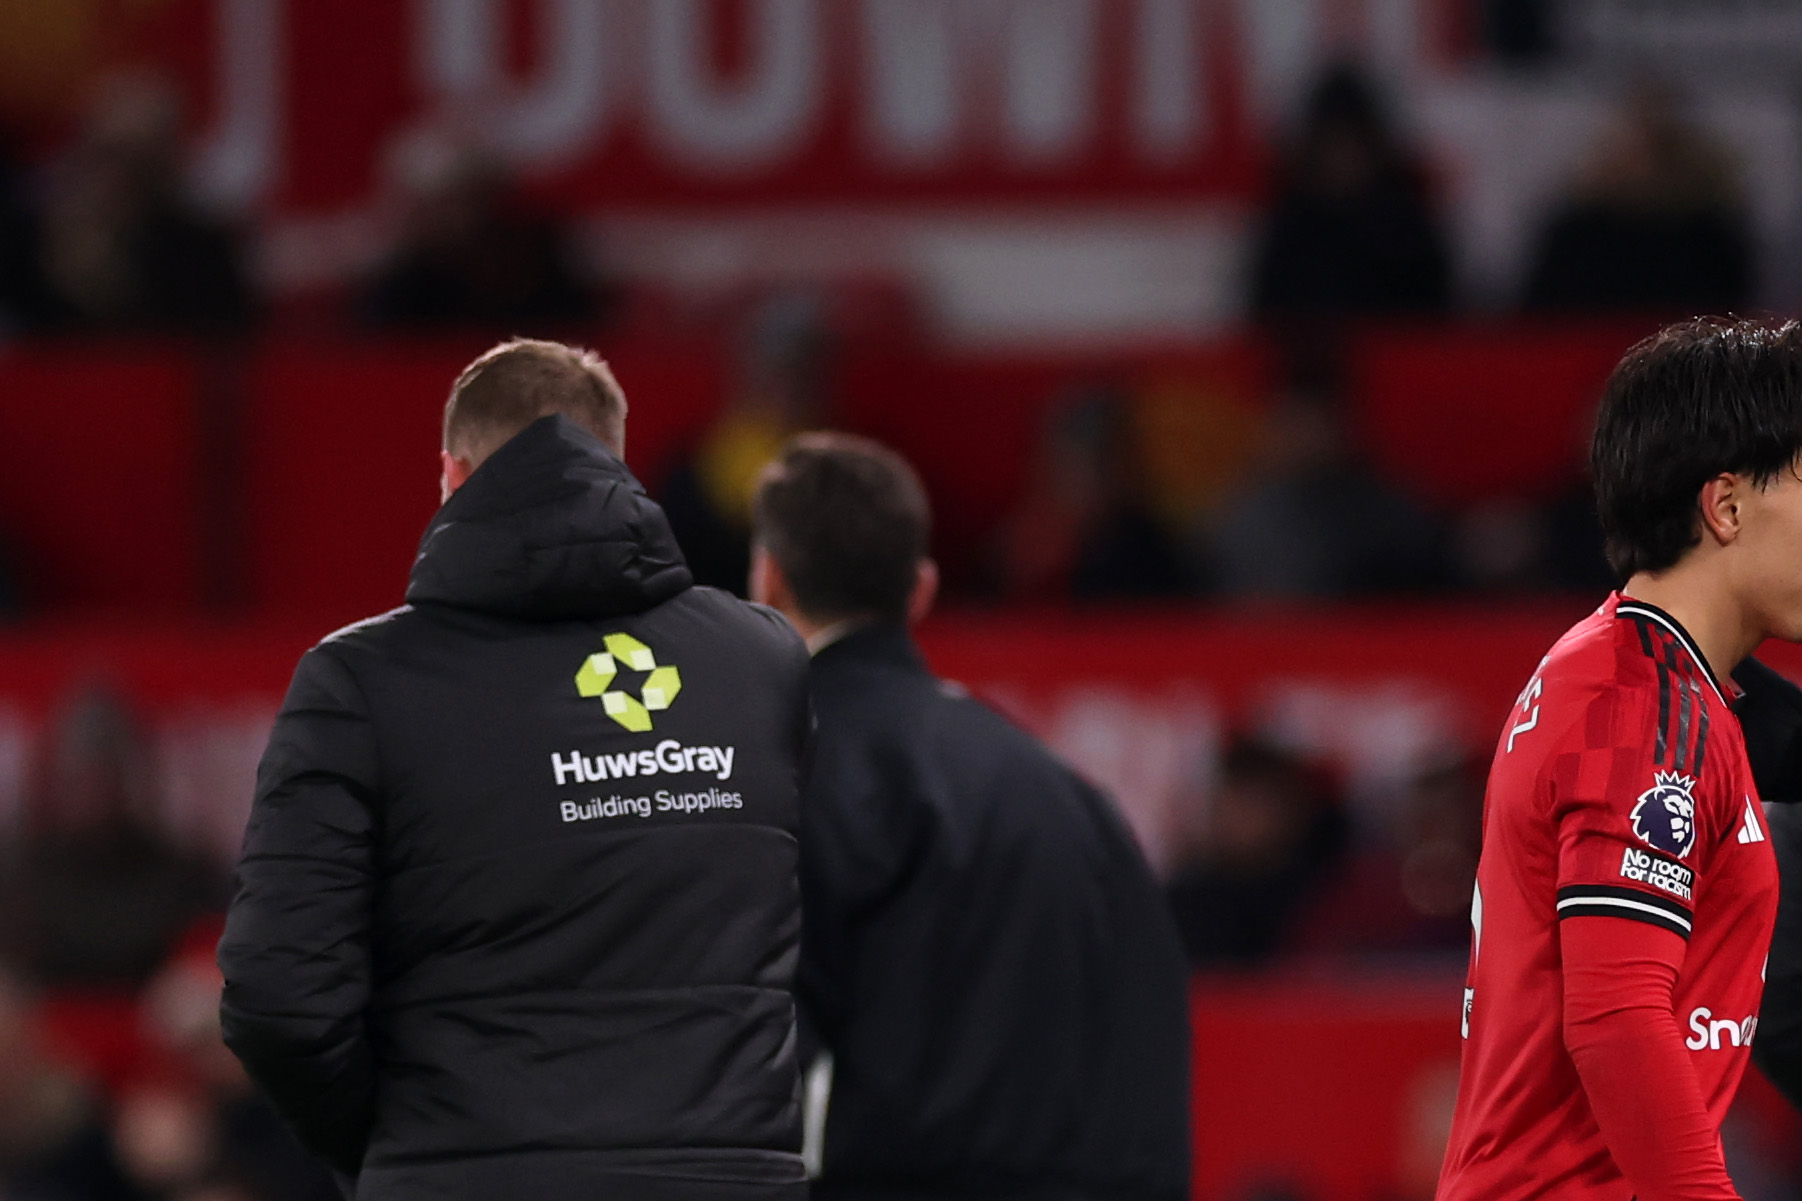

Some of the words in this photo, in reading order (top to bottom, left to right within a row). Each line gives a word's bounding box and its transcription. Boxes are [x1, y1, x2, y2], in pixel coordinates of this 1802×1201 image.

[552, 740, 735, 785] HuwsGray
[560, 796, 651, 822] Building
[655, 788, 743, 814] Supplies
[1623, 847, 1651, 869] No
[1651, 858, 1692, 885] room
[1648, 871, 1692, 900] racism
